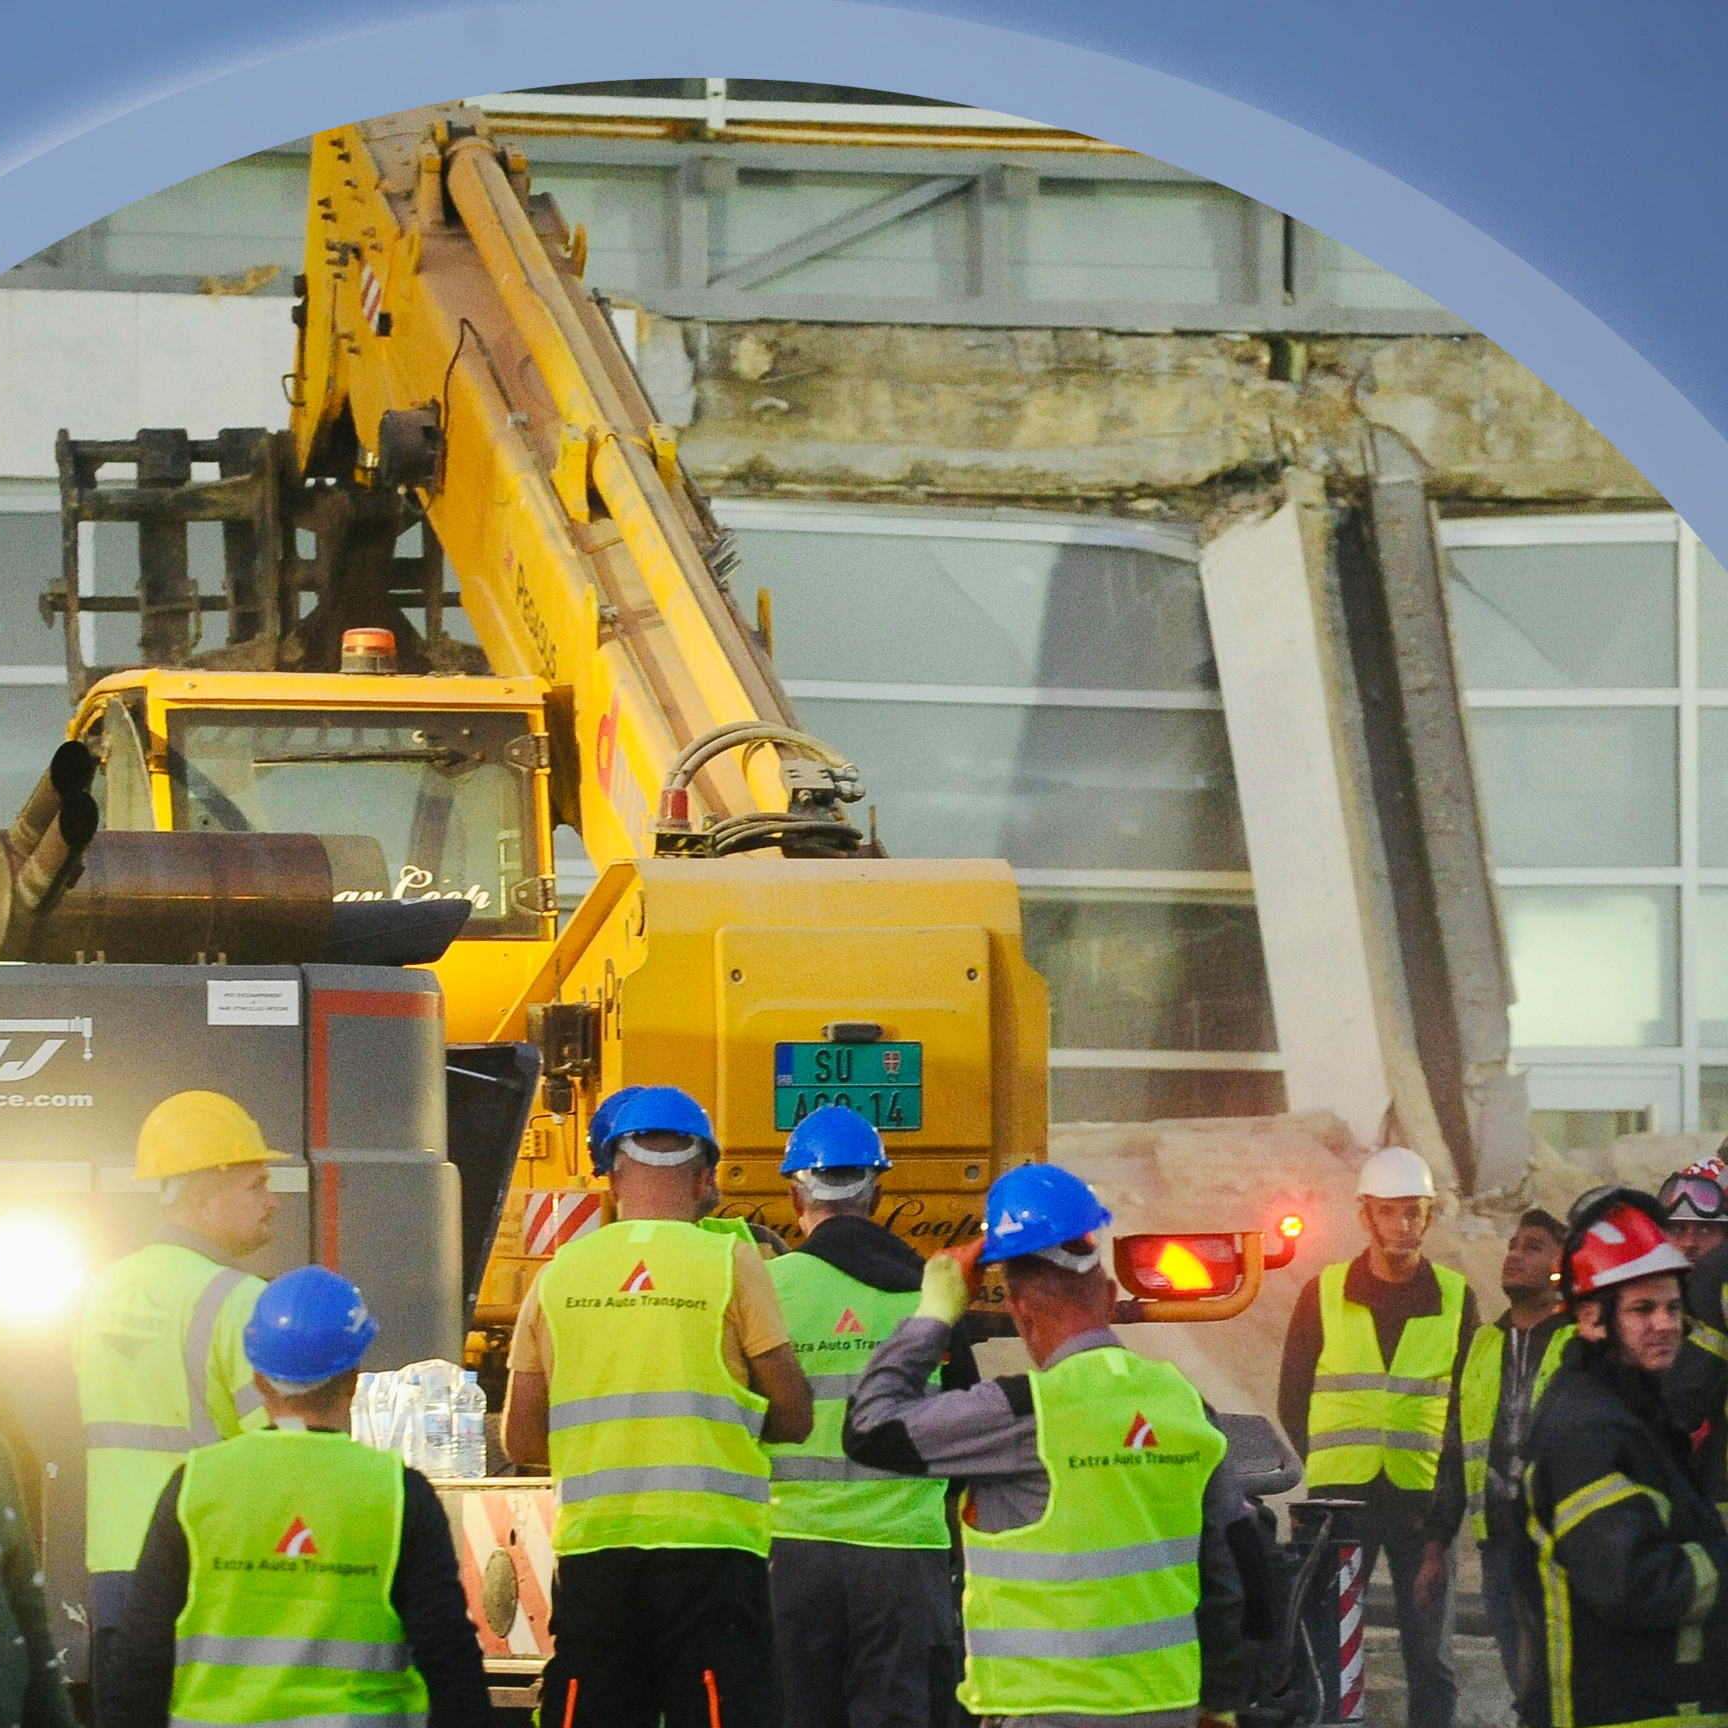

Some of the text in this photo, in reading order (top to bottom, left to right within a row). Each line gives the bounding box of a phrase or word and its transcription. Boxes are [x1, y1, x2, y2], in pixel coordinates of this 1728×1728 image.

[814, 1047, 853, 1084] SU
[565, 1294, 709, 1311] Extra Auto Transport
[793, 1339, 814, 1354] tra
[817, 1339, 851, 1352] Auto
[213, 1557, 254, 1571] Extra
[258, 1558, 297, 1573] Auto
